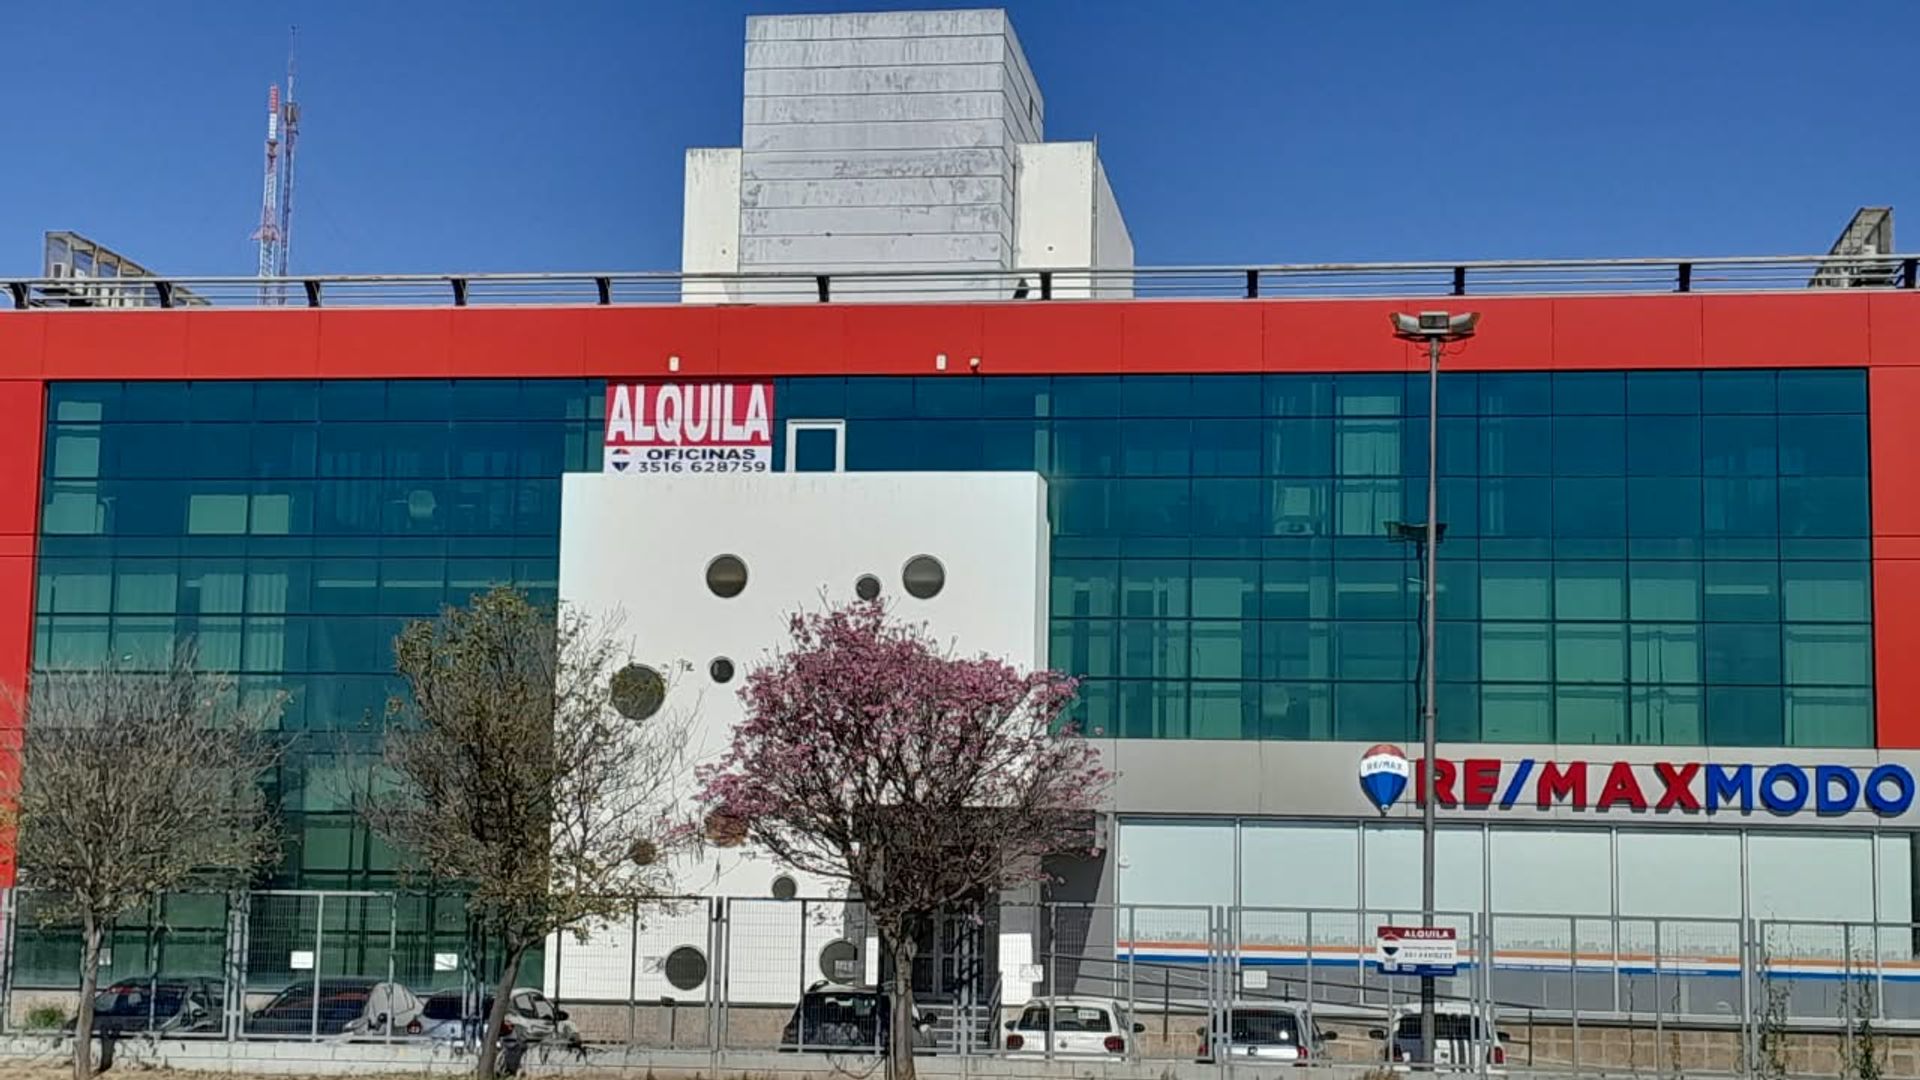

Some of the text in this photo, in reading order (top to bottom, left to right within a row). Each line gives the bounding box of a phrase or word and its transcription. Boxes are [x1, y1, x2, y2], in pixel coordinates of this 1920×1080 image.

[606, 384, 770, 446] ALQUILA
[646, 448, 756, 460] OFICINAS
[638, 461, 766, 473] 3516 628759
[1403, 930, 1449, 938] ALQUILA
